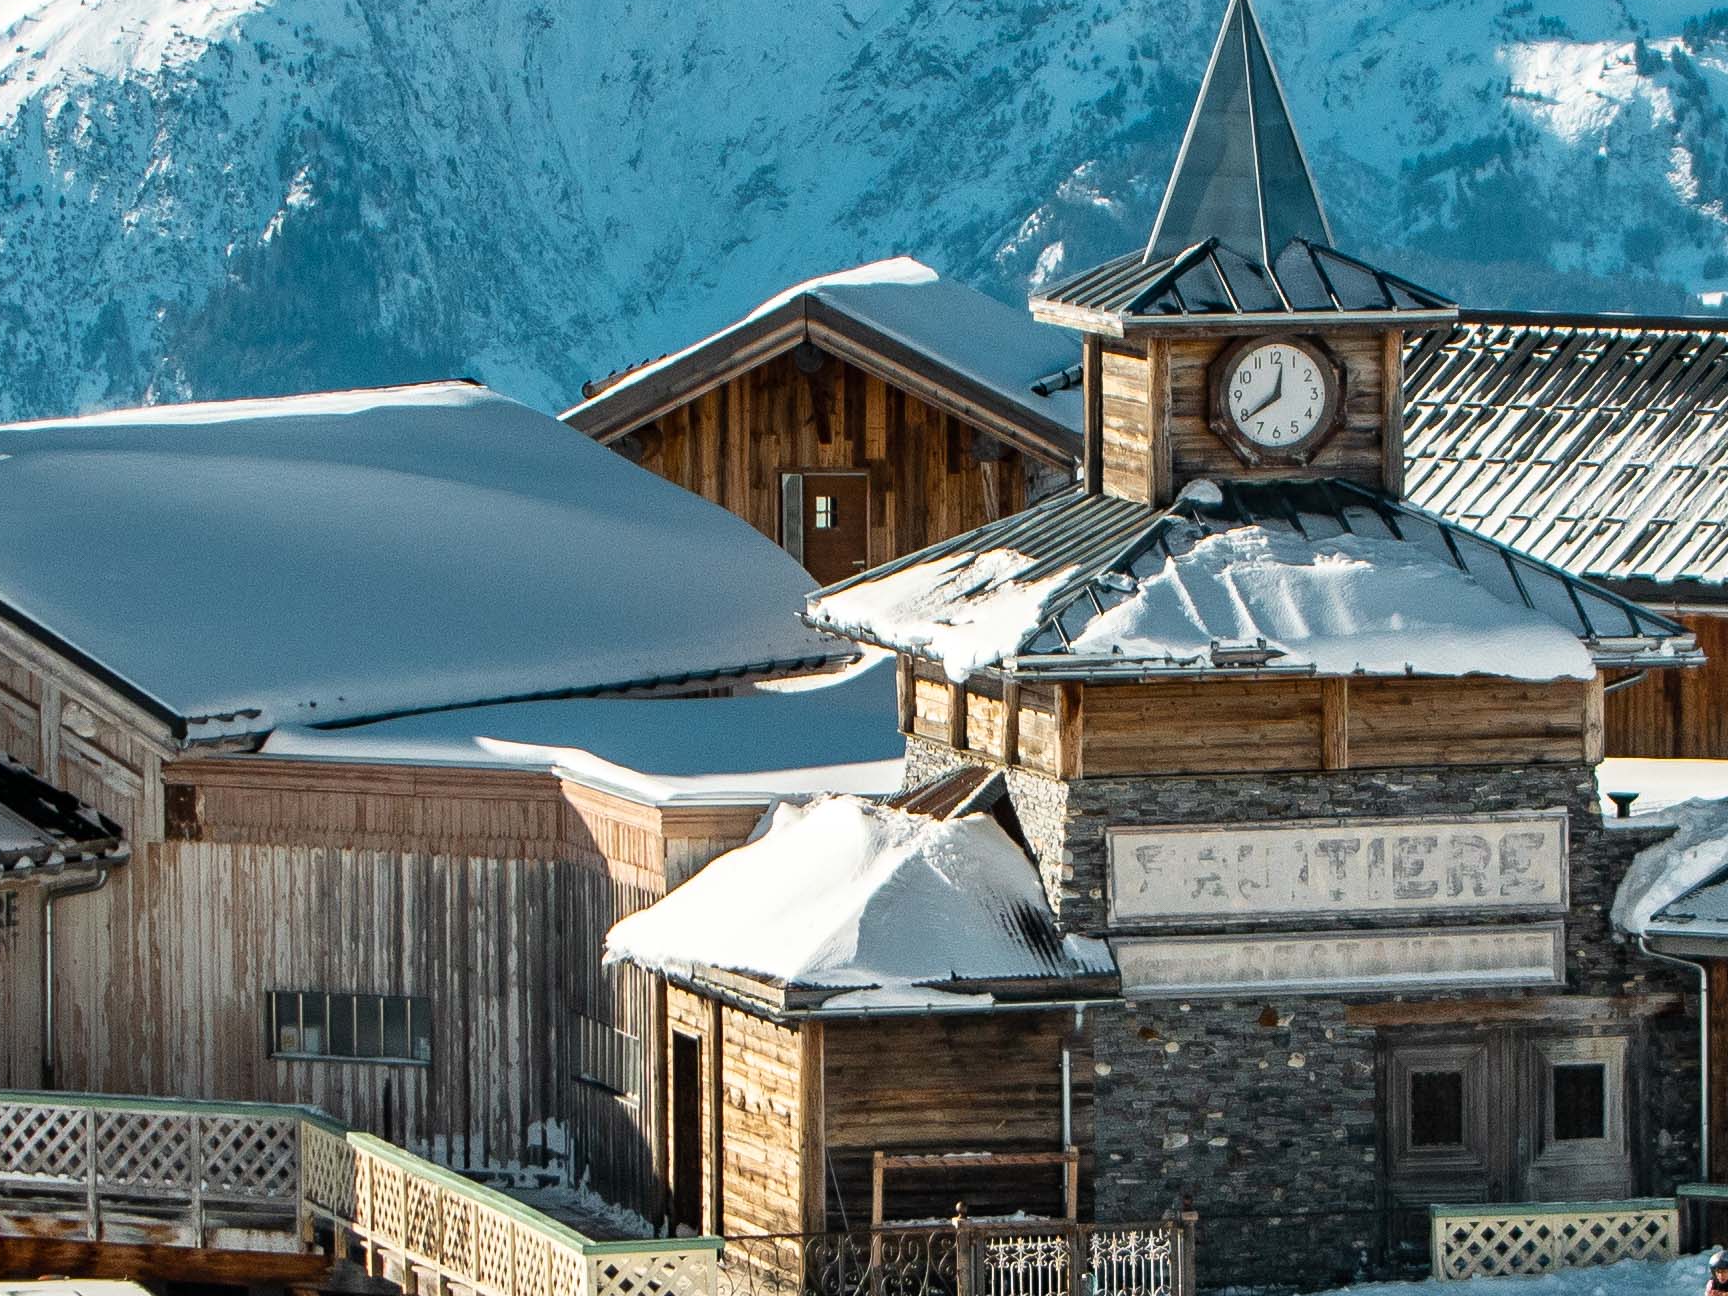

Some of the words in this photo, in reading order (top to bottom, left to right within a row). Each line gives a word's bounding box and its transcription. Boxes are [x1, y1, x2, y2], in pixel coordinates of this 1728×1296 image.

[1254, 356, 1262, 369] 11
[1270, 351, 1282, 365] 12
[1239, 371, 1252, 384] 10
[1303, 369, 1313, 382] 2
[1234, 390, 1243, 403] 9
[1310, 387, 1319, 400] 3
[1240, 408, 1249, 422] 8
[1304, 407, 1313, 419] 4
[1256, 422, 1264, 435] 7
[1272, 425, 1281, 439] 6
[1290, 420, 1299, 434] 5
